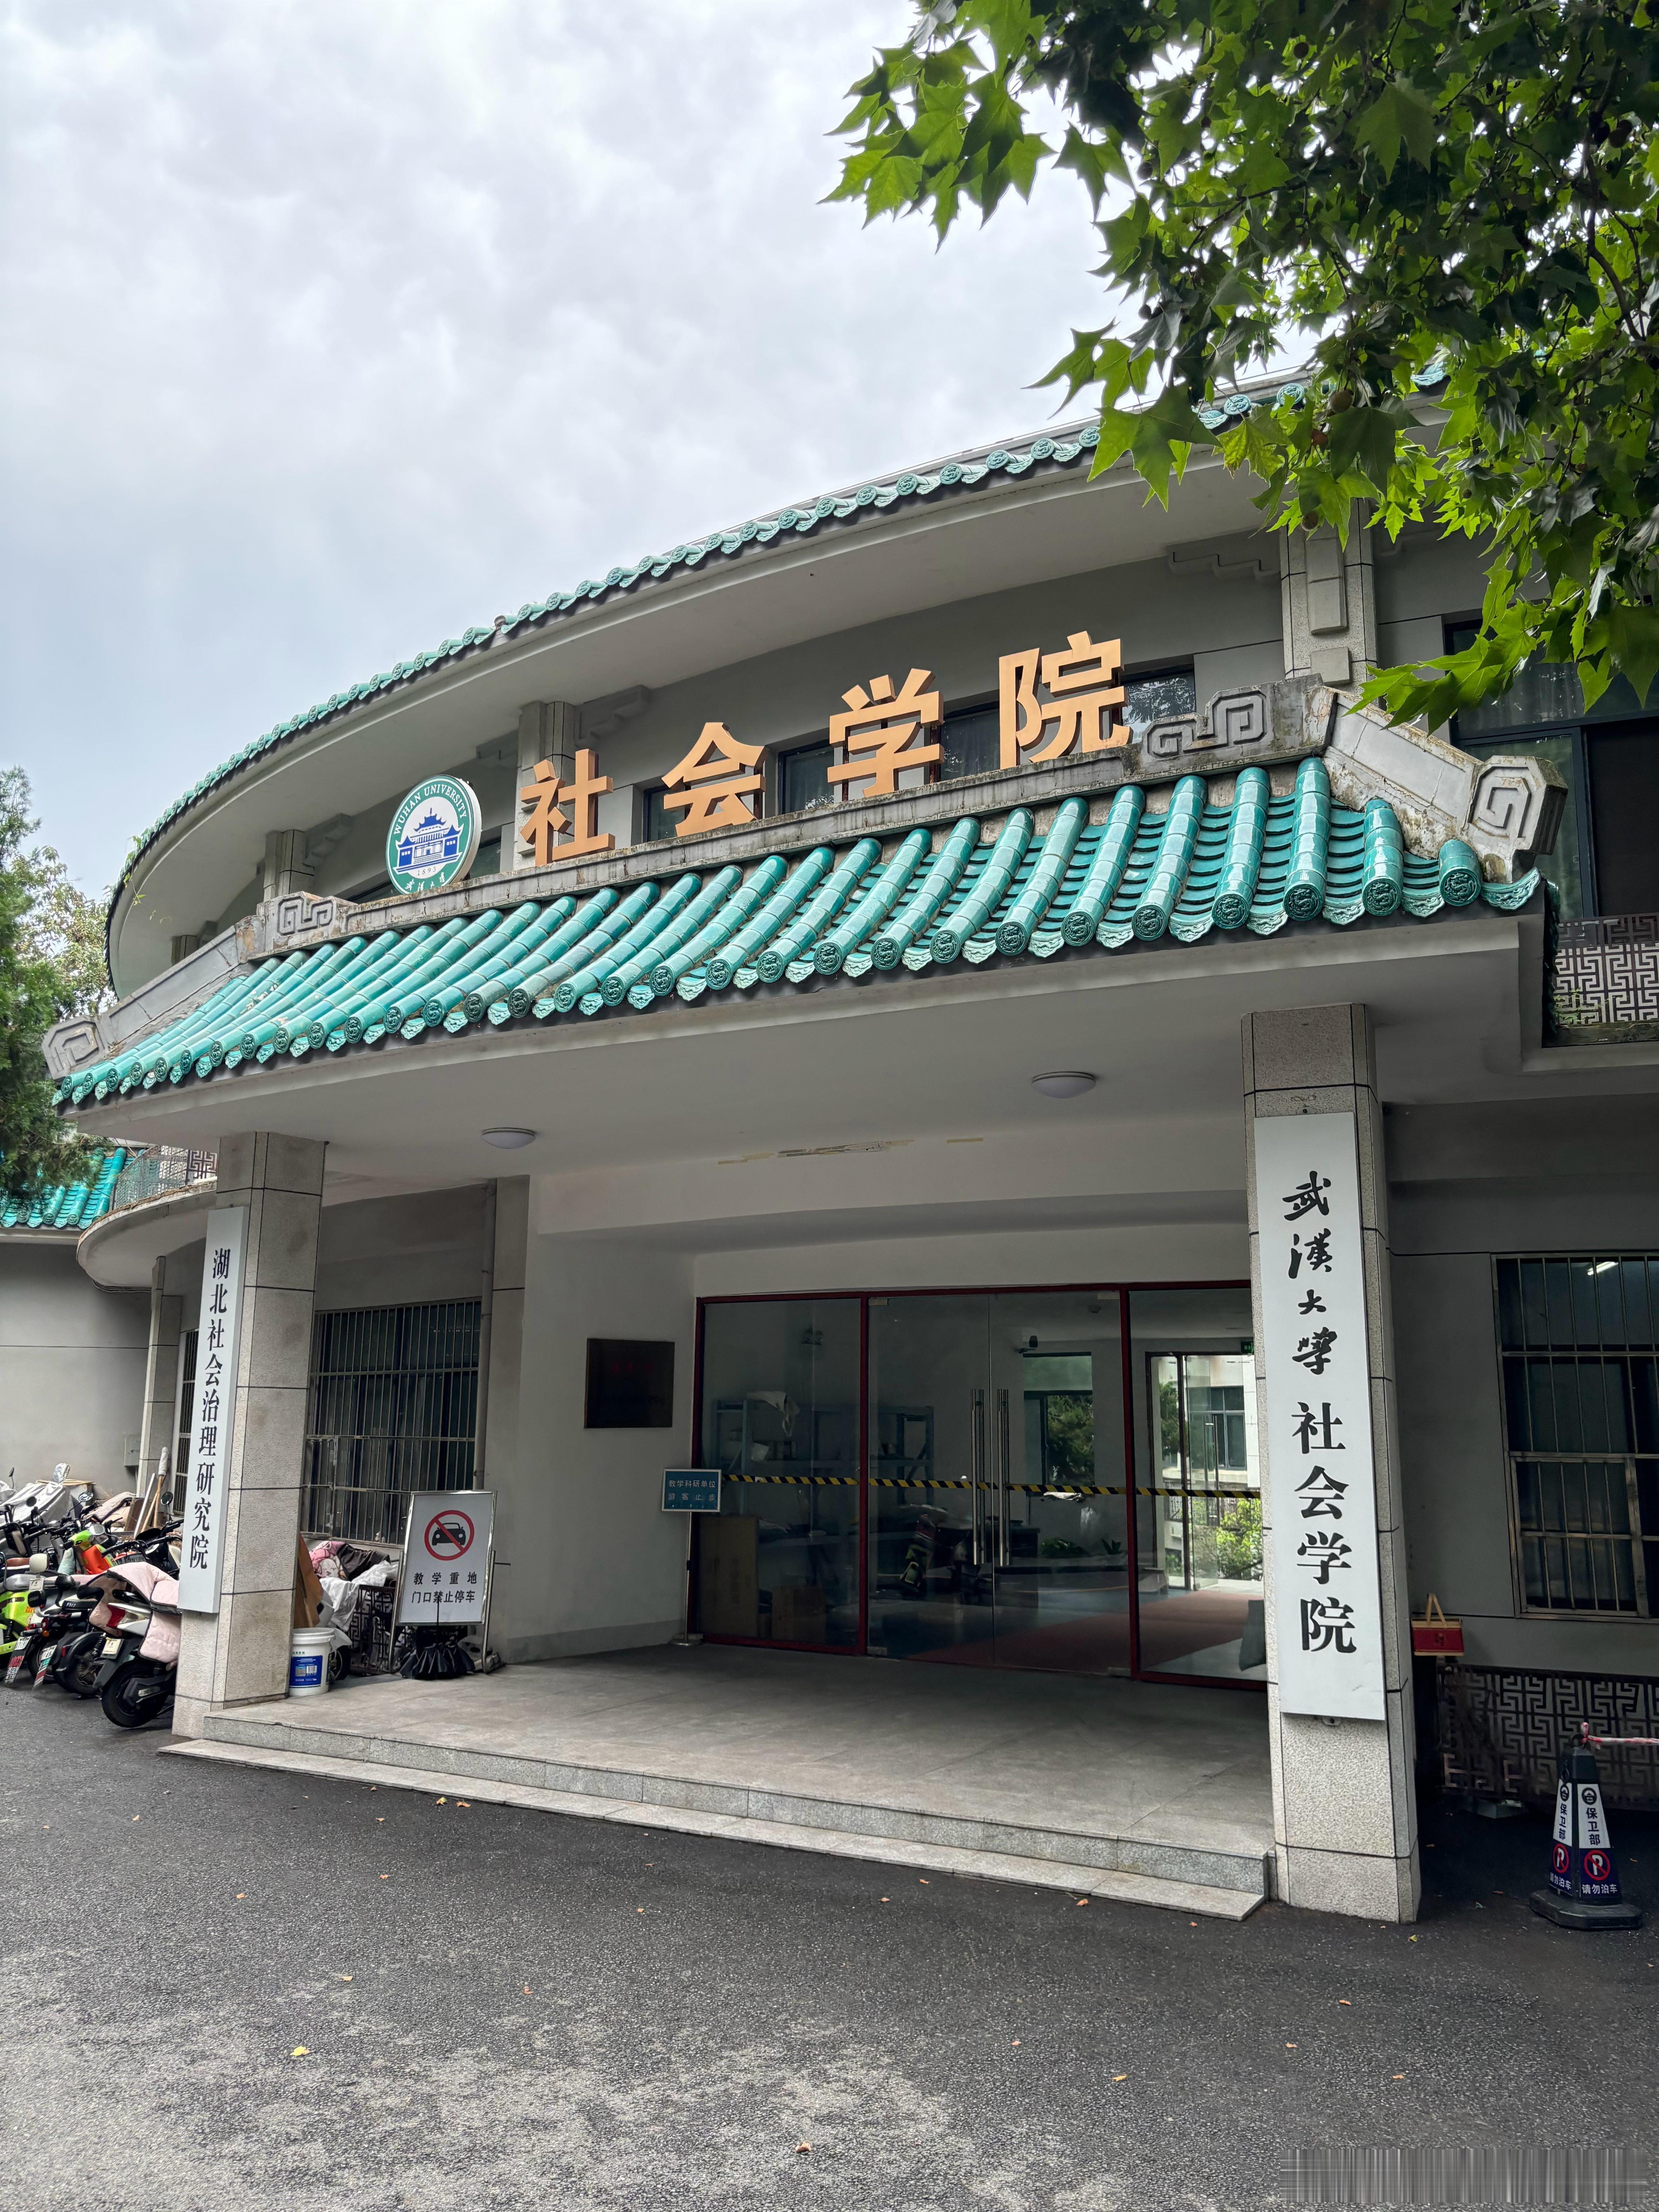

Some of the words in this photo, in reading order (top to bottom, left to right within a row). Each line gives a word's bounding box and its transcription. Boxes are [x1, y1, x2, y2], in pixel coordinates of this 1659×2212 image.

[520, 631, 1133, 866] 社会学院
[393, 792, 421, 835] WUHAN
[424, 784, 467, 819] UNIVERSITY
[417, 867, 436, 876] 1893
[189, 1247, 232, 1570] 湖北社会治理研究院
[412, 1590, 475, 1603] 门口禁止停车
[414, 1571, 477, 1585] 教学重地
[1559, 1803, 1567, 1840] 保卫部
[1586, 1807, 1601, 1846] 保卫部
[1581, 1883, 1618, 1894] 请勿泊车
